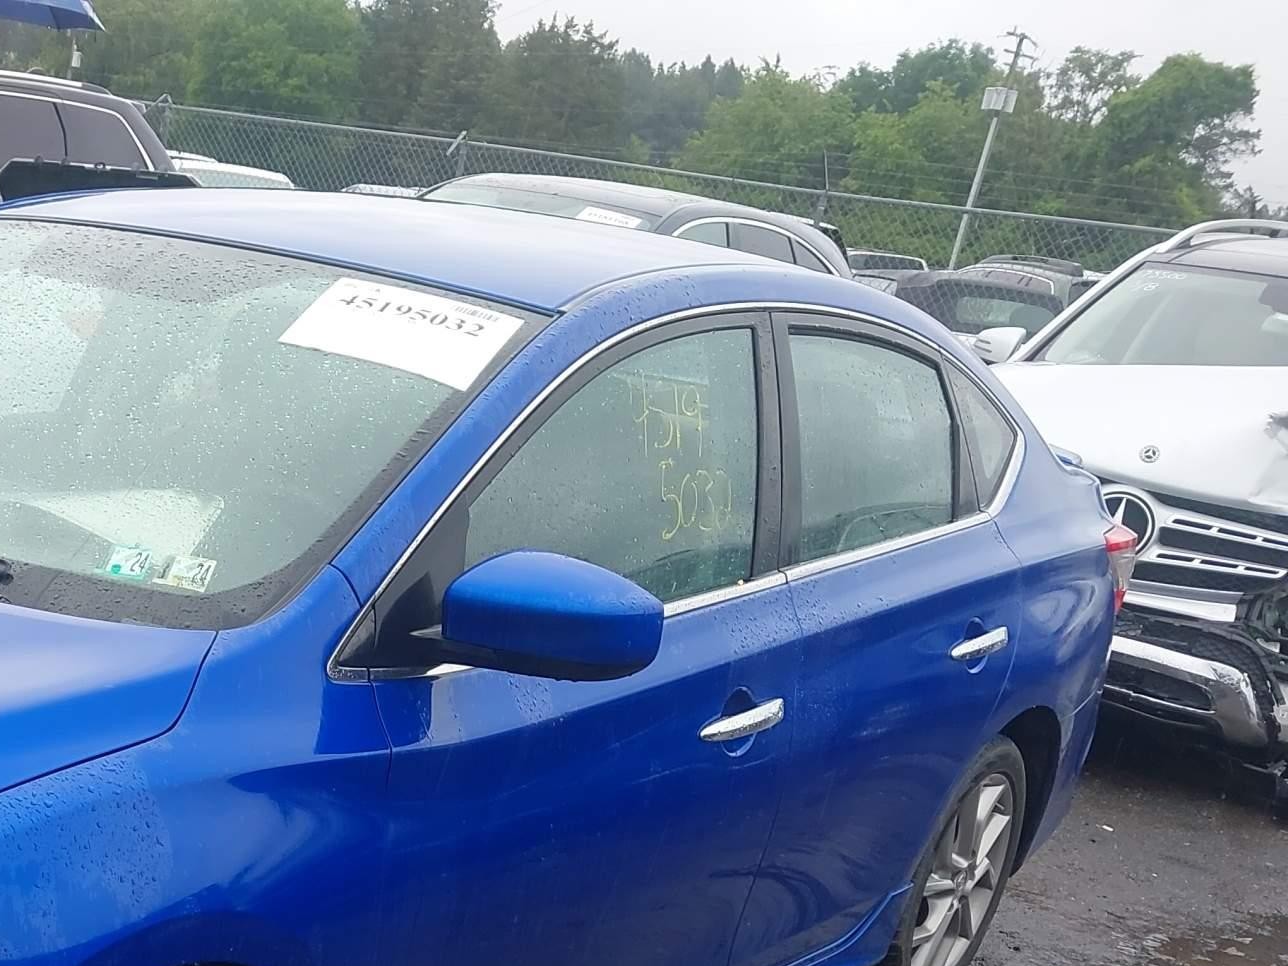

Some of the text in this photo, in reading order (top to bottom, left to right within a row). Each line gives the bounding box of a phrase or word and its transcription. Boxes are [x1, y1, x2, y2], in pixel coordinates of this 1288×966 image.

[339, 294, 486, 338] 45195032
[129, 551, 151, 574] 24
[191, 562, 212, 586] 24
